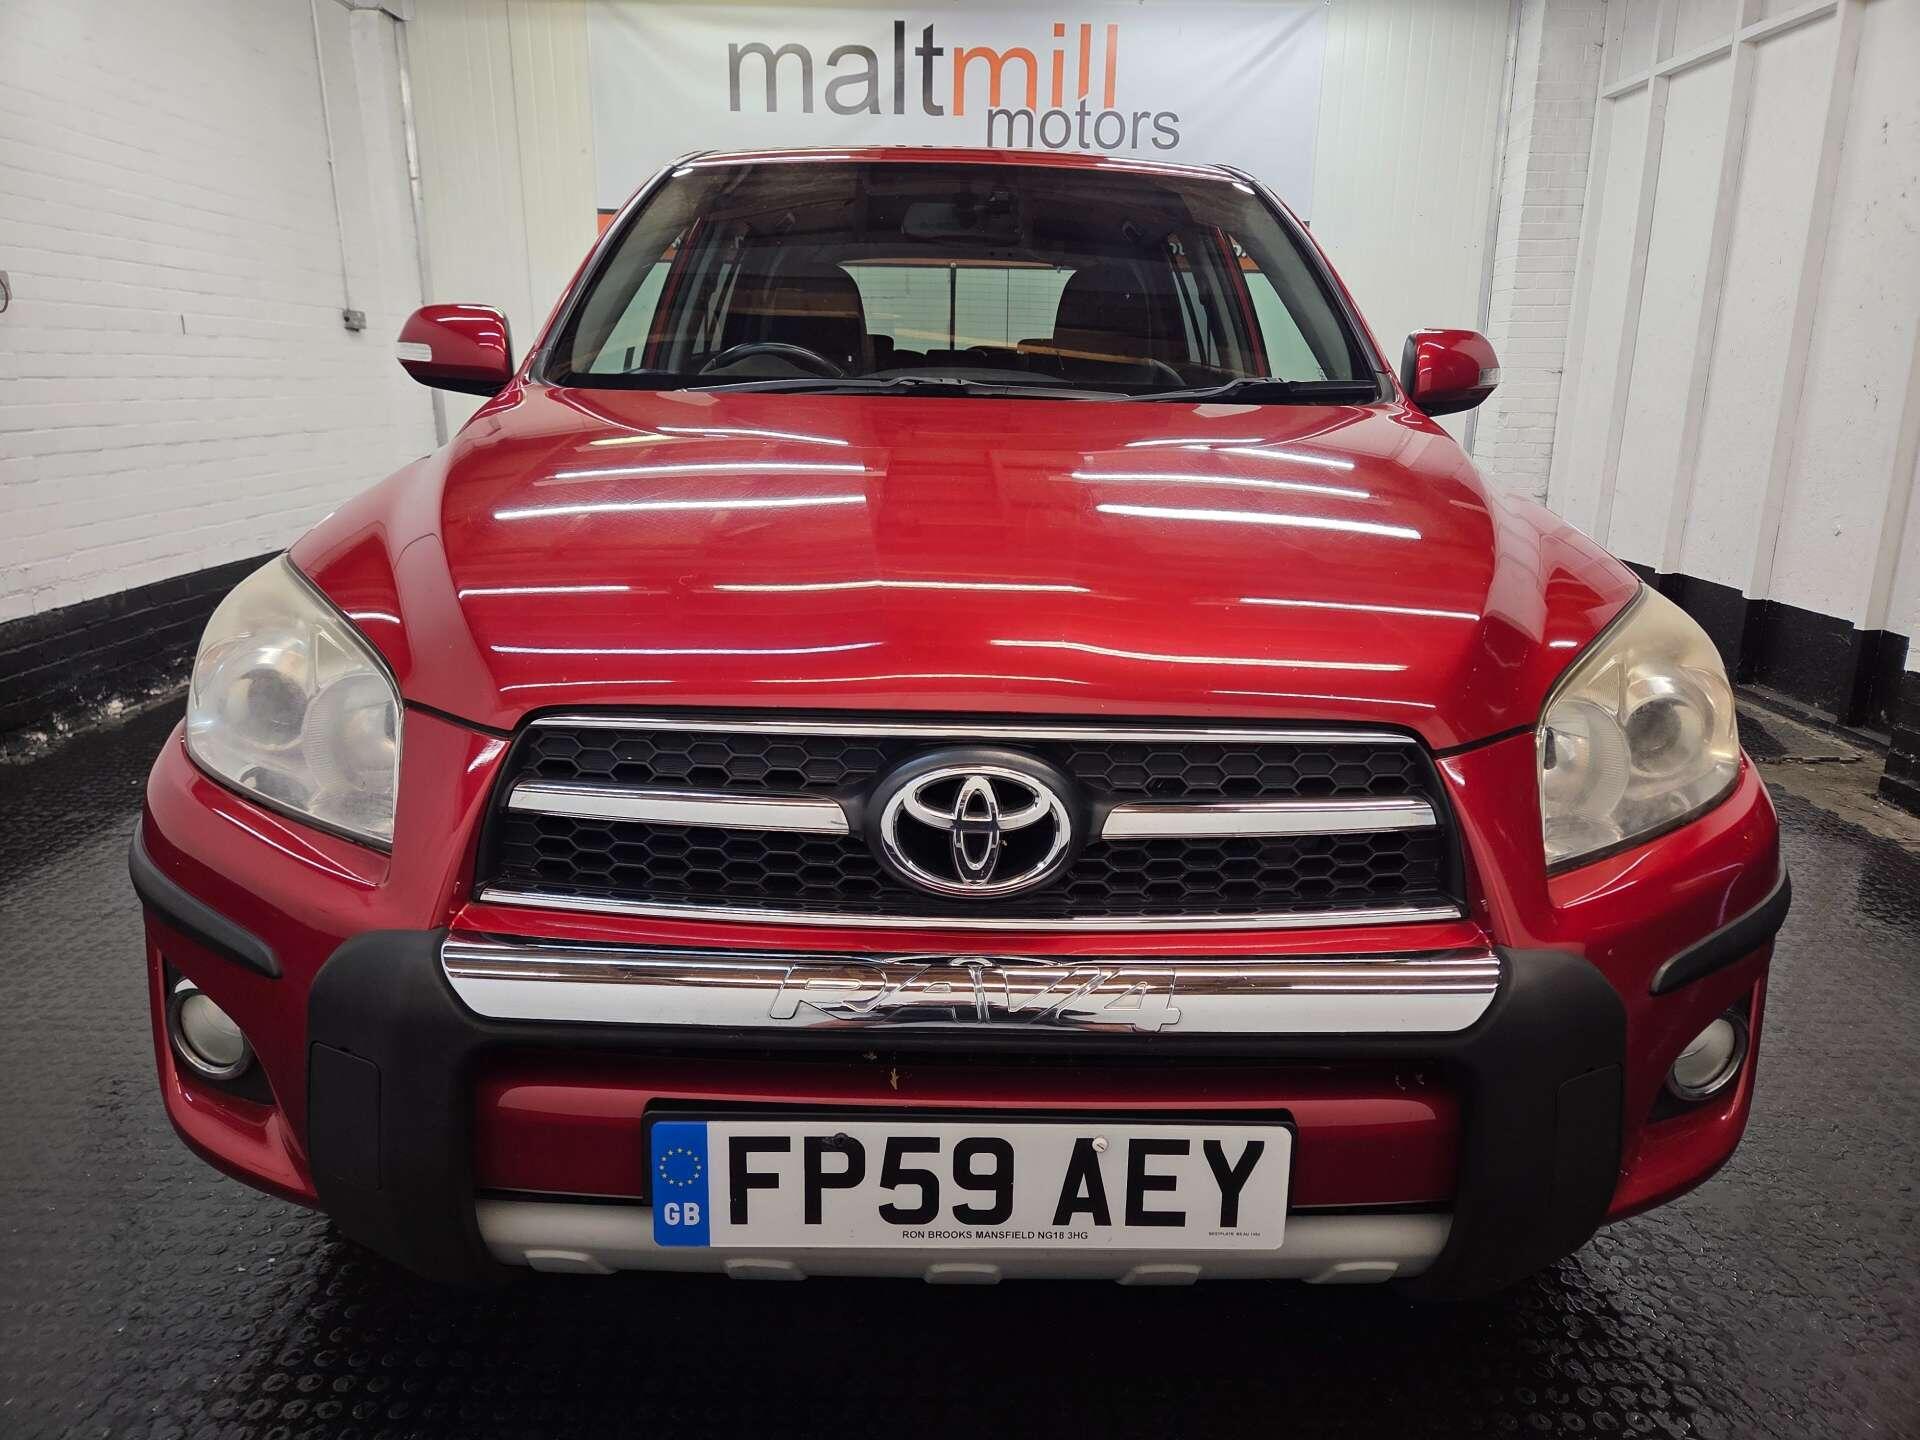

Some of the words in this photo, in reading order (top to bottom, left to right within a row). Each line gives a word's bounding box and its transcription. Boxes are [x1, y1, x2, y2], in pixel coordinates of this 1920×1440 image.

[986, 99, 1181, 150] motors
[768, 962, 1183, 1033] RAV4
[728, 1134, 1015, 1226] FP59
[1051, 1137, 1265, 1228] AEY
[664, 1202, 701, 1226] GB
[902, 1230, 925, 1239] RON
[927, 1230, 973, 1239] BROOKS
[975, 1230, 1035, 1240] MANSFIELD
[1037, 1231, 1065, 1240] NG18
[1067, 1231, 1089, 1240] 3HG
